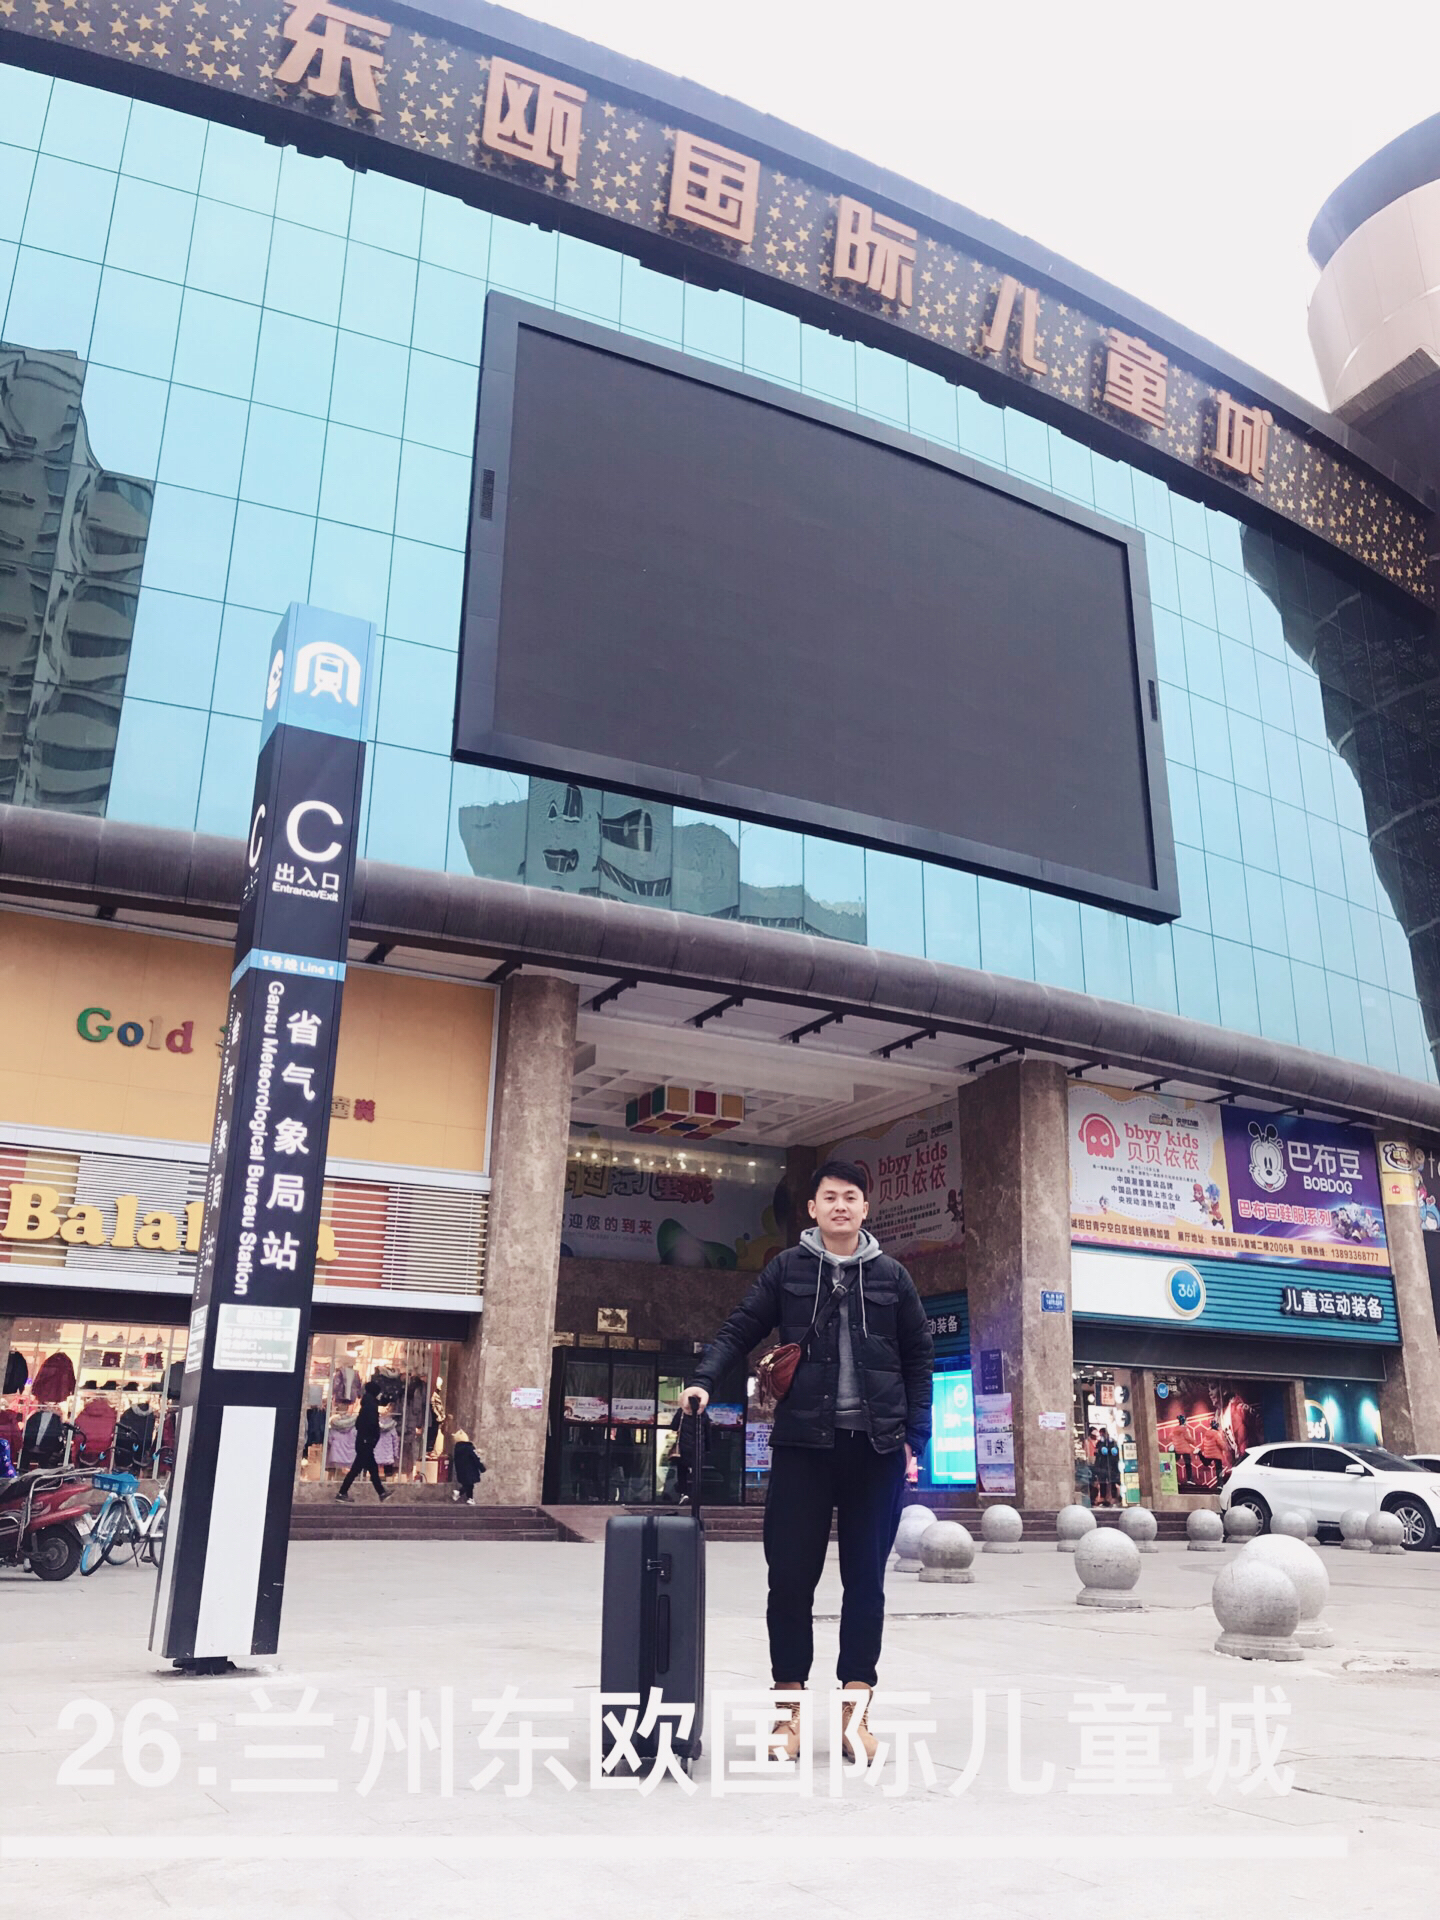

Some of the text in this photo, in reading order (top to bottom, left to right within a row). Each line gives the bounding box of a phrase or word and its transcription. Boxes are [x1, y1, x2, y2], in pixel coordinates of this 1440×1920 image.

[286, 800, 344, 863] C
[275, 863, 340, 891] 出入口
[272, 882, 339, 902] Entrance/Exit
[300, 961, 325, 975] Line
[77, 1007, 194, 1054] Gold
[234, 981, 285, 1296] Gansu Meteorological Bureau Station
[260, 1010, 323, 1271] 省气象局站
[1124, 1123, 1199, 1149] bbyy kids
[878, 1142, 948, 1176] bbyy kids
[1128, 1142, 1199, 1171] 贝贝依依
[1287, 1140, 1363, 1181] 巴布豆
[879, 1163, 947, 1205] 贝贝依依
[1304, 1176, 1353, 1194] BOBDOG
[562, 1213, 653, 1235] 迎您的到来
[1237, 1199, 1333, 1228] 巴布豆鞋服系列
[1284, 1289, 1383, 1319] 儿童运动装备
